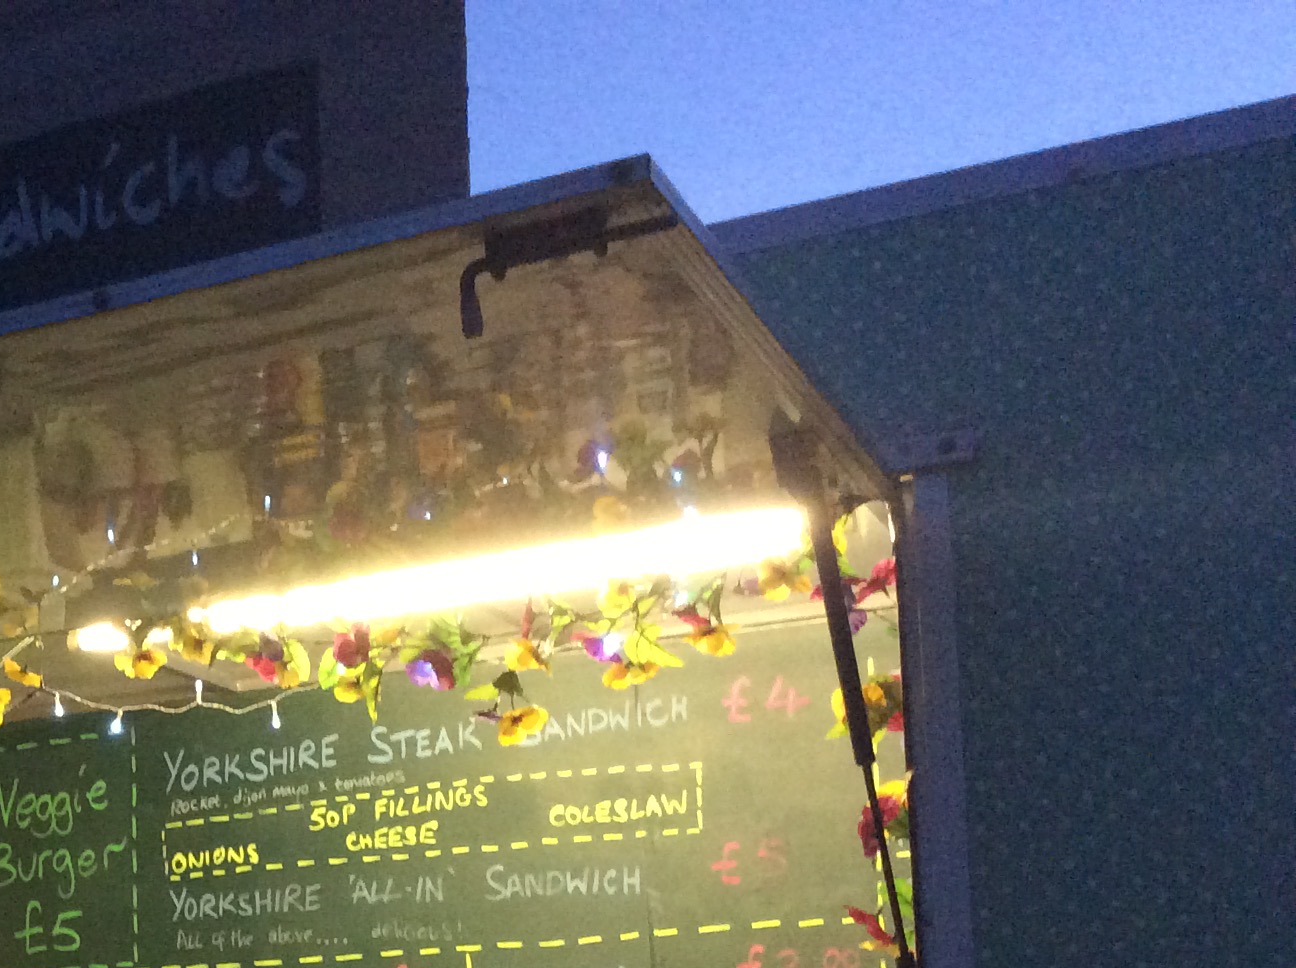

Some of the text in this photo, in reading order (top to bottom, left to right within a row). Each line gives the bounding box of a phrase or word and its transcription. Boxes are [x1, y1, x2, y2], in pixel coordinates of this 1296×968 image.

[164, 733, 340, 794] YORKSHIRE
[367, 716, 484, 765] STEAK
[374, 783, 489, 822] FILLINGS
[548, 788, 688, 827] COLESLAW
[345, 819, 439, 852] CHEESE
[170, 842, 260, 875] ONIONS
[170, 883, 322, 923] YORKSHIRE
[485, 863, 642, 902] SANDWICH
[14, 900, 84, 955] £5
